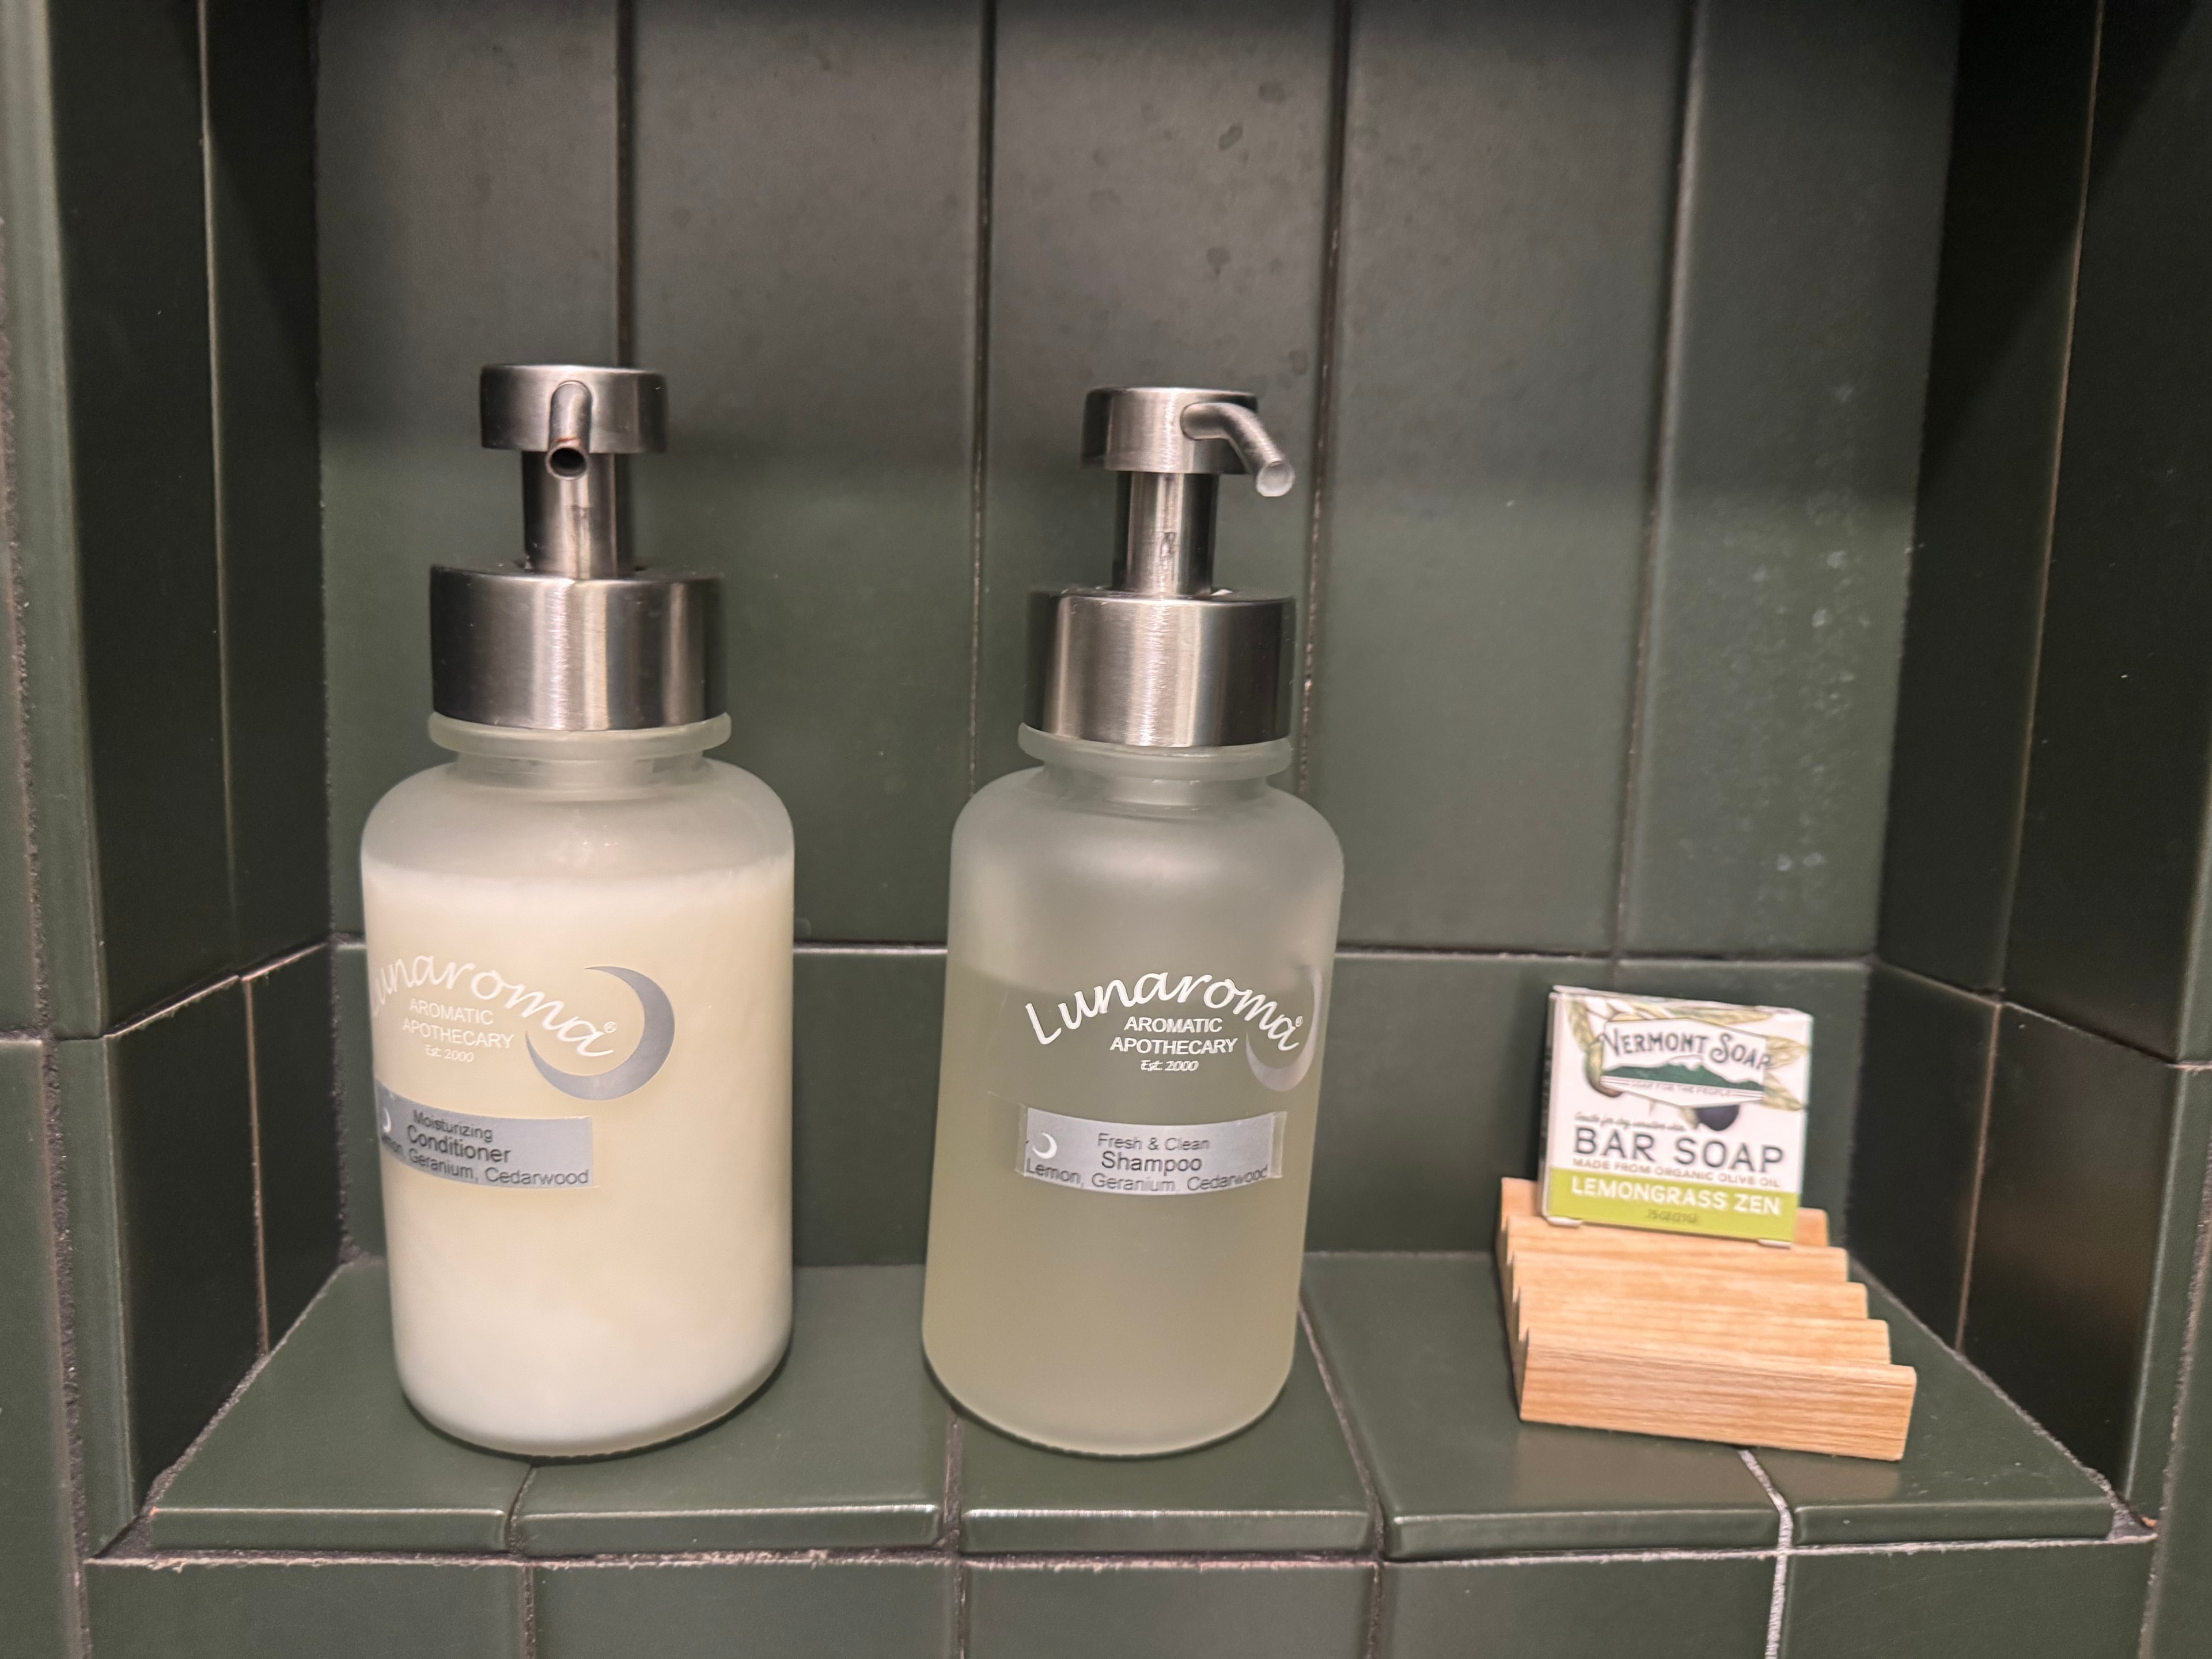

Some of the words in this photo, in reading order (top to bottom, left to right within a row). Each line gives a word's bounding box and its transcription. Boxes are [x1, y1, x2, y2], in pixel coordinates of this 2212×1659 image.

[373, 955, 614, 1057] unaroma
[410, 998, 494, 1025] AROMATIC
[403, 1017, 514, 1049] APOTHECARY
[1123, 1016, 1223, 1033] AROMATIC
[444, 1048, 475, 1063] 2000
[1109, 1037, 1238, 1055] APOTHECARY
[1164, 1060, 1199, 1071] 2000
[413, 1109, 493, 1143] Moisturizing
[1097, 1132, 1143, 1150] Fresh
[1146, 1137, 1159, 1151] &
[1164, 1137, 1210, 1150] Clean
[407, 1125, 512, 1163] Conditioner
[1573, 1127, 1656, 1162] BAR
[1674, 1135, 1785, 1173] SOAP
[409, 1148, 479, 1183] Geranium,
[484, 1166, 589, 1185] Cedarwood
[1025, 1157, 1085, 1188] Lemon,
[1187, 1164, 1268, 1191] Cedarwood
[1101, 1151, 1203, 1176] Shampoo
[1572, 1157, 1610, 1170] MADE
[1614, 1162, 1651, 1175] FROM
[1654, 1165, 1714, 1181] ORGANIC
[1718, 1172, 1755, 1186] OLIVE
[1759, 1177, 1781, 1188] OIL
[1571, 1175, 1728, 1210] LEMONGRASS
[1733, 1193, 1782, 1215] ZEN
